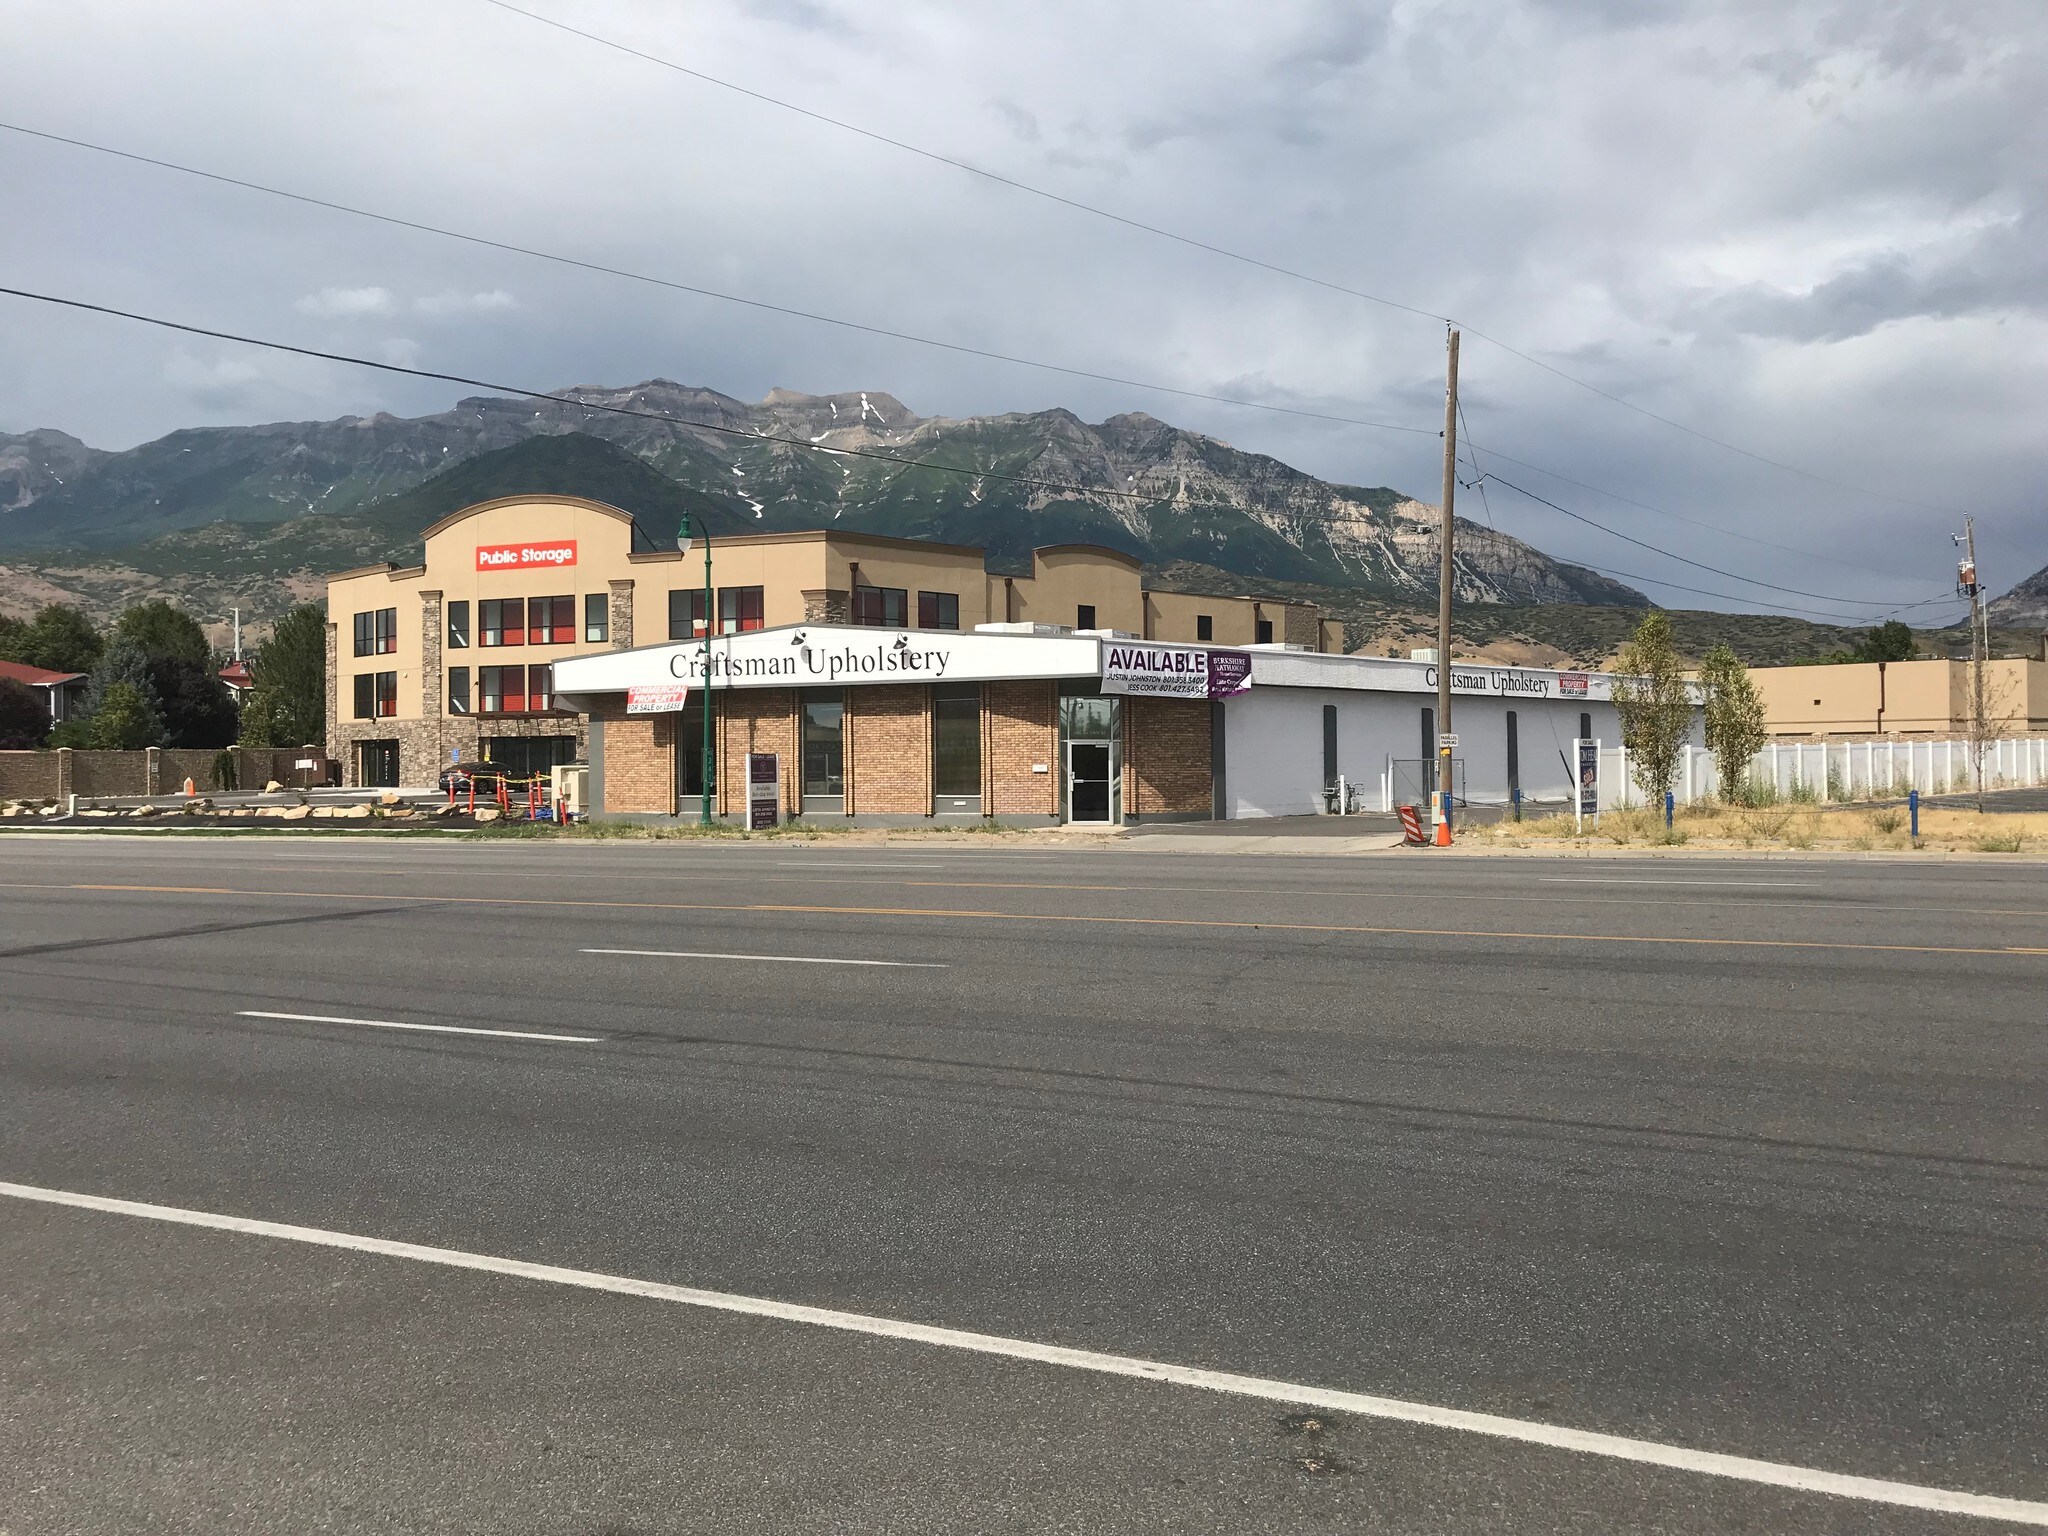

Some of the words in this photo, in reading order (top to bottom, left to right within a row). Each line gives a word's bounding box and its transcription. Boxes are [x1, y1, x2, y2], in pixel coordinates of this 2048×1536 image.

[479, 550, 518, 565] Public
[521, 548, 573, 564] Storage
[670, 652, 796, 679] Craftsman
[806, 645, 950, 680] Upholstery
[1108, 648, 1205, 673] AVAILABLE
[1213, 657, 1246, 665] BERKSHIRE
[1106, 673, 1129, 681] JUSTIN
[1128, 674, 1161, 683] JOHNSTON
[1490, 671, 1549, 698] Upholstery
[629, 686, 688, 695] COMMERCIAL
[633, 694, 679, 703] PROPERTY
[627, 704, 639, 712] FOR
[640, 703, 654, 711] SALE
